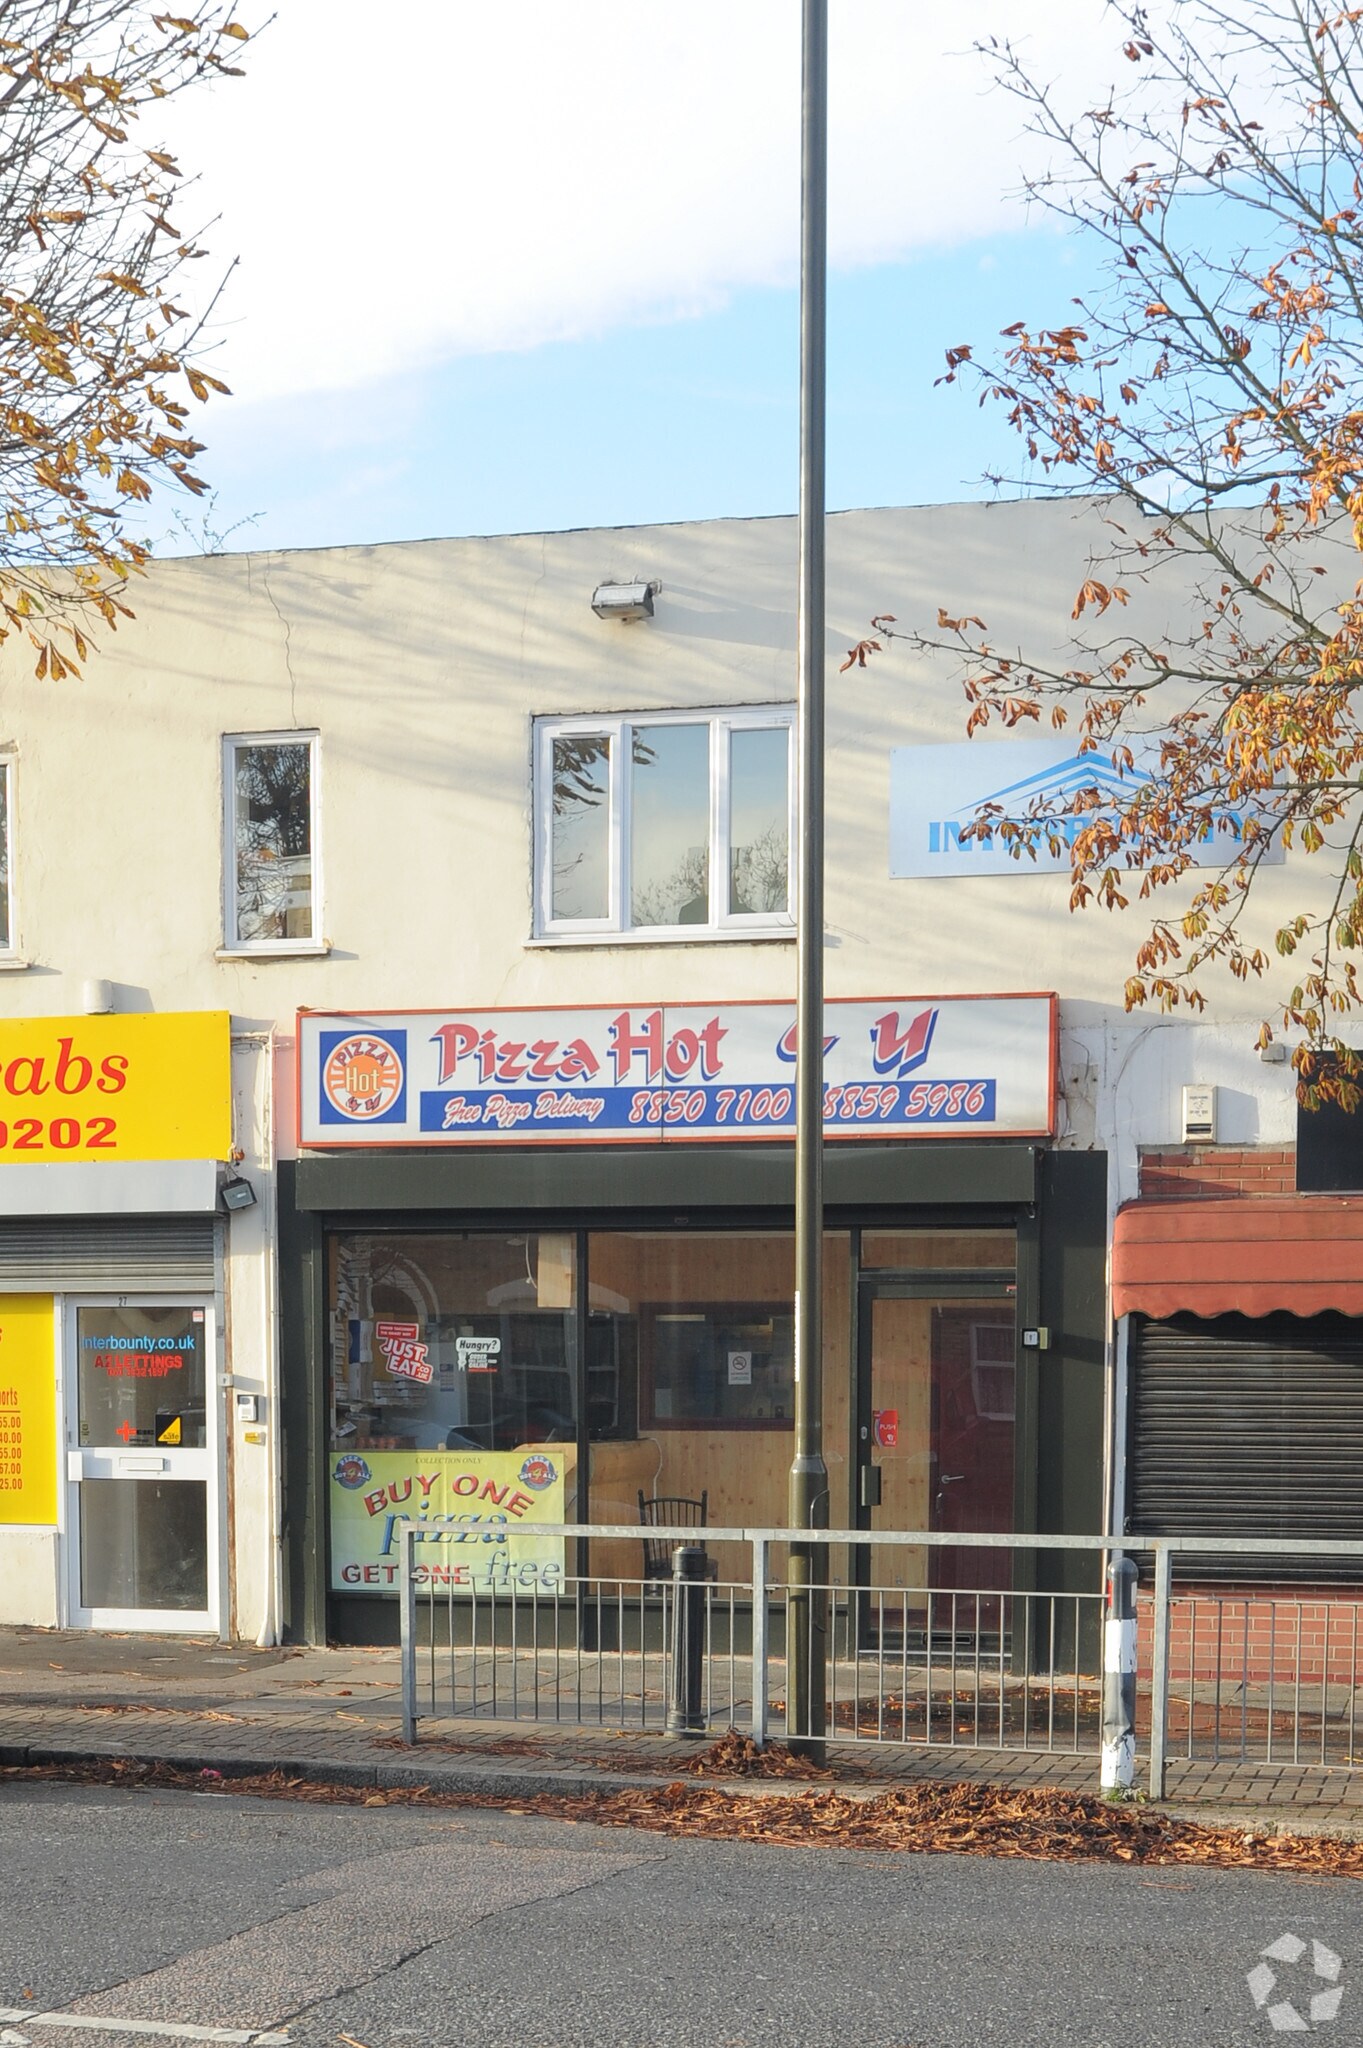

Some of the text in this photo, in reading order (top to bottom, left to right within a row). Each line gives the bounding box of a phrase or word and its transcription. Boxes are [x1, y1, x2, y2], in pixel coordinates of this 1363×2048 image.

[335, 1041, 389, 1067] PIZZA
[429, 1023, 600, 1085] Pizza
[607, 1010, 729, 1085] Hot
[0, 1037, 129, 1096] abs
[346, 1066, 380, 1092] Hot
[443, 1091, 604, 1128] Free Pizza Delivery
[629, 1083, 986, 1123] 8850 7100 8859 5986
[0, 1117, 117, 1149] 202
[383, 1339, 425, 1361] JUST
[460, 1339, 497, 1351] Hungry?
[115, 1354, 182, 1369] LETTINGS
[389, 1355, 420, 1376] EAT
[0, 1387, 18, 1406] orts
[363, 1472, 535, 1517] BUY ONE
[378, 1500, 508, 1555] pizza
[341, 1551, 560, 1587] GET ONE free
